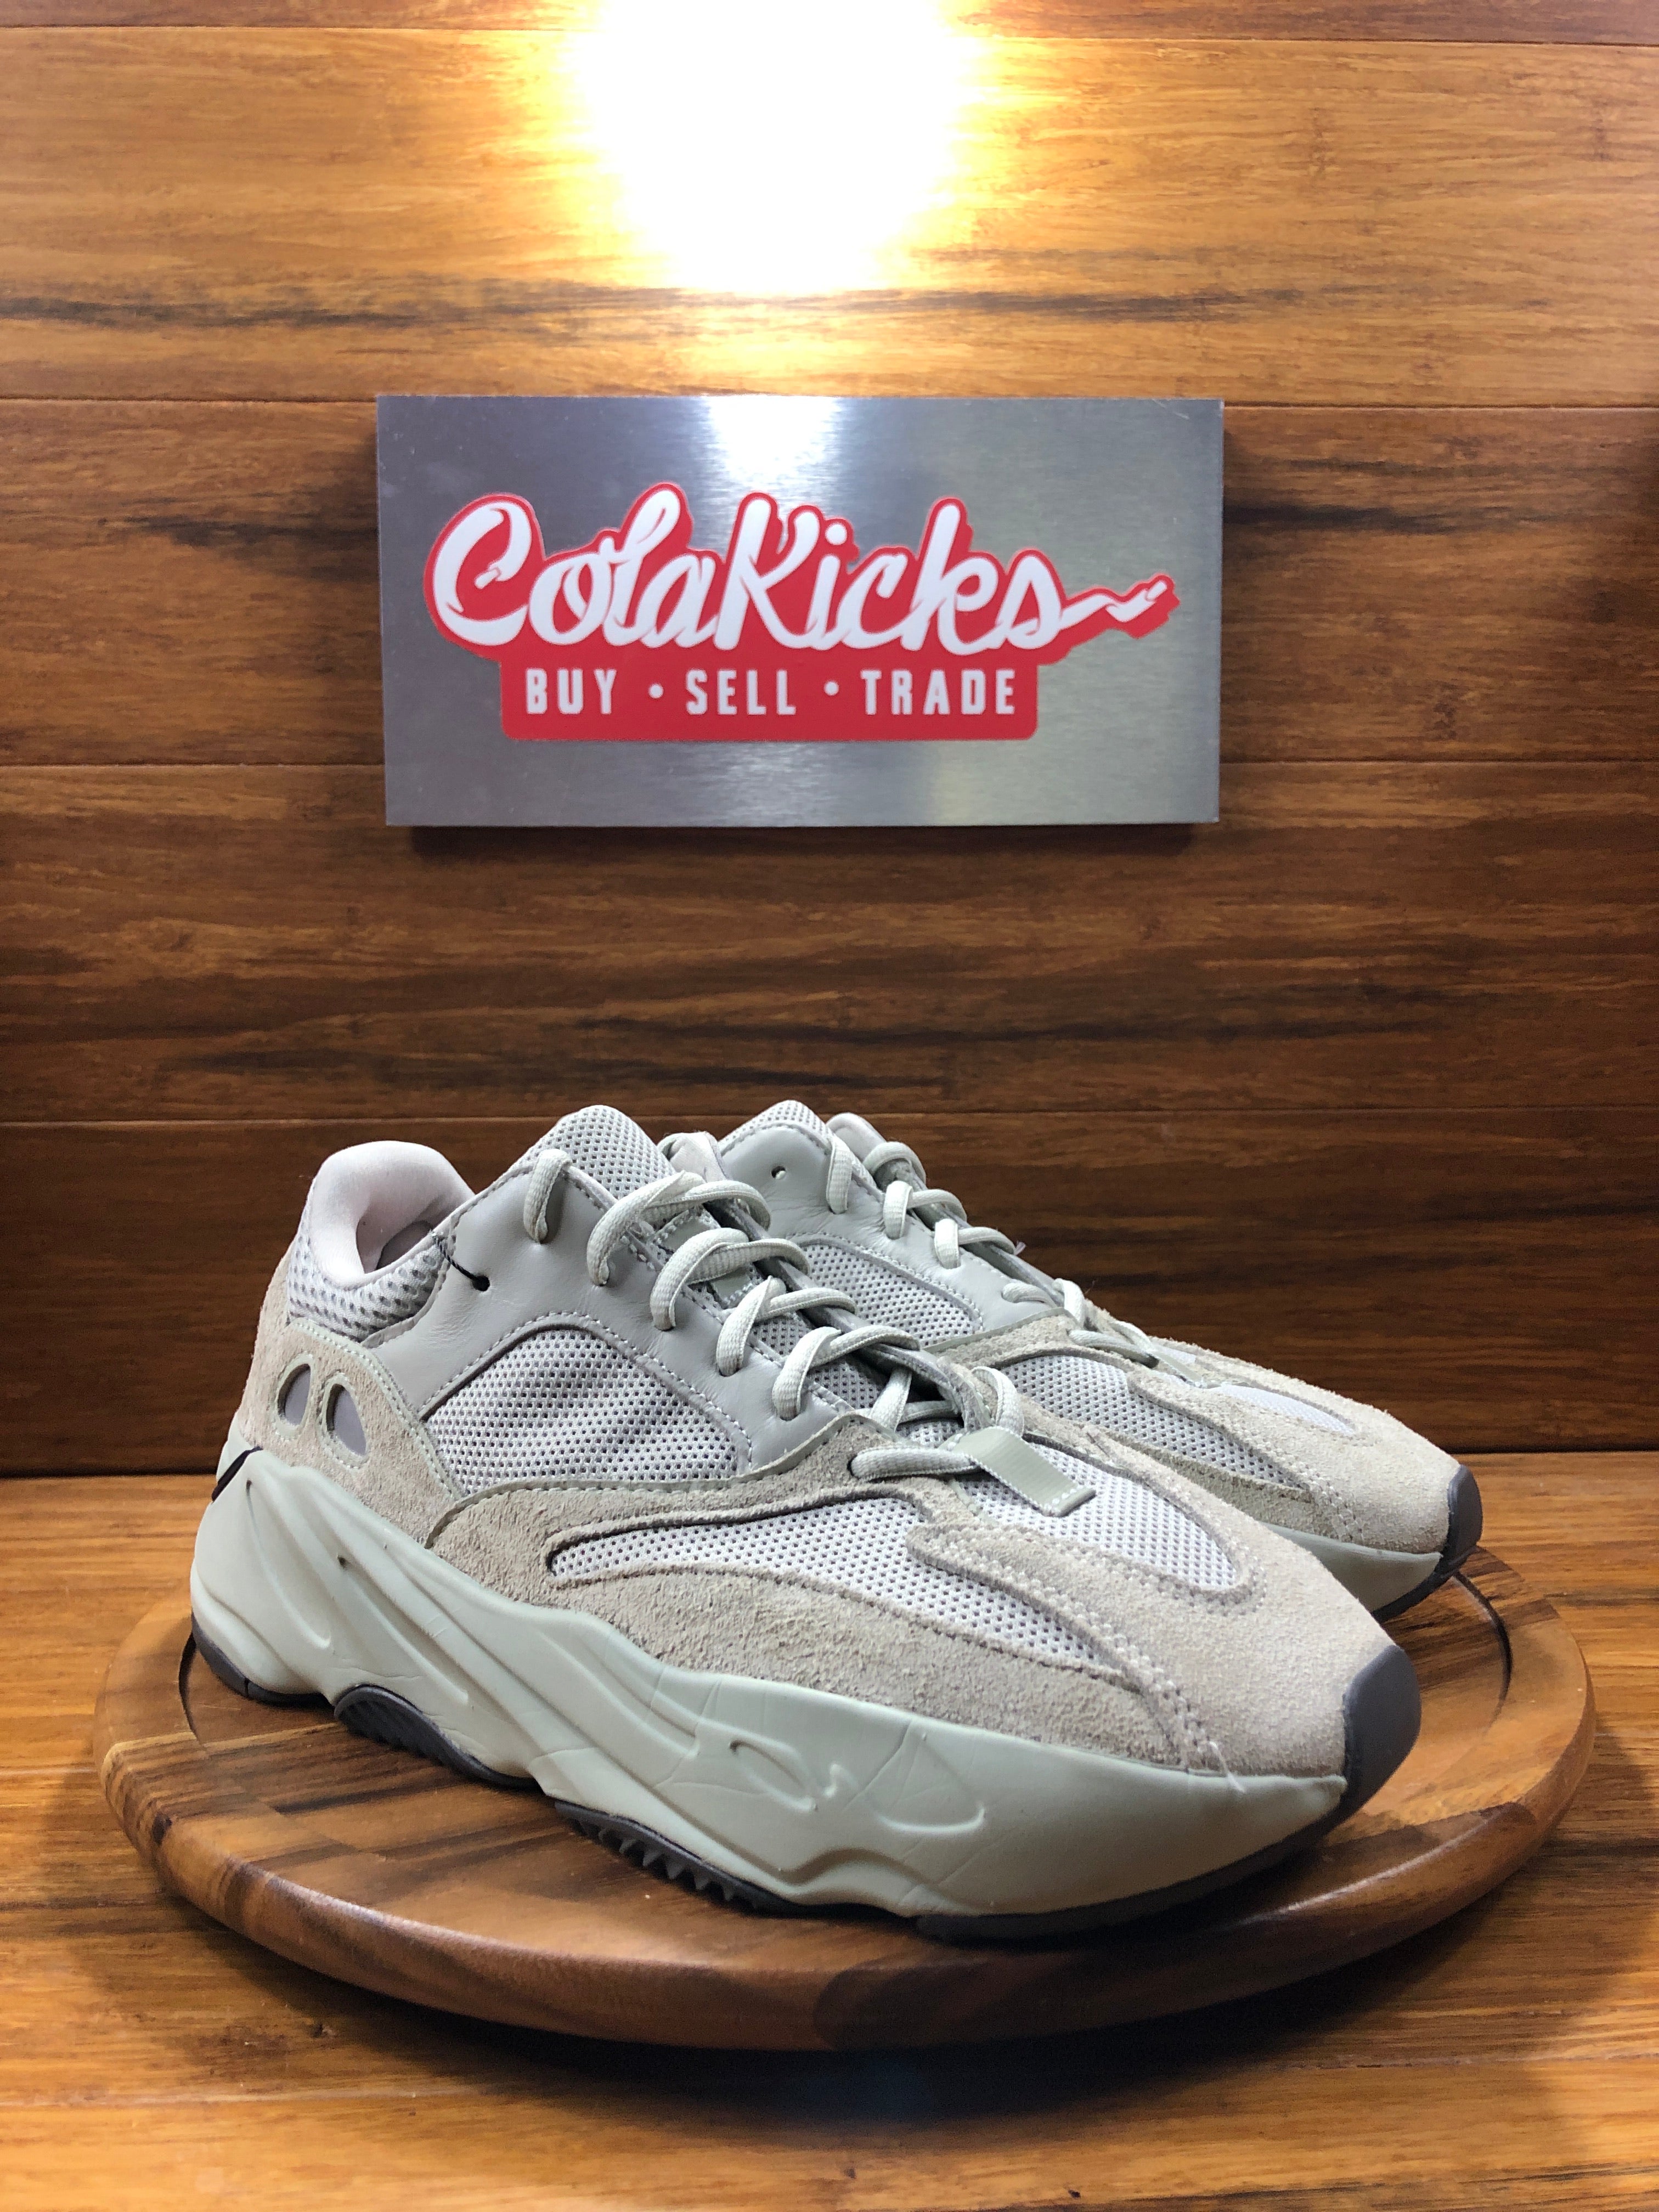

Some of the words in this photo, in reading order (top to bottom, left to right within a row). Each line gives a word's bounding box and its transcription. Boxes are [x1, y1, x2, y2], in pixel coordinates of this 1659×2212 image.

[526, 669, 617, 715] BUY
[686, 669, 797, 715] SELL
[860, 669, 1015, 715] TRADE
